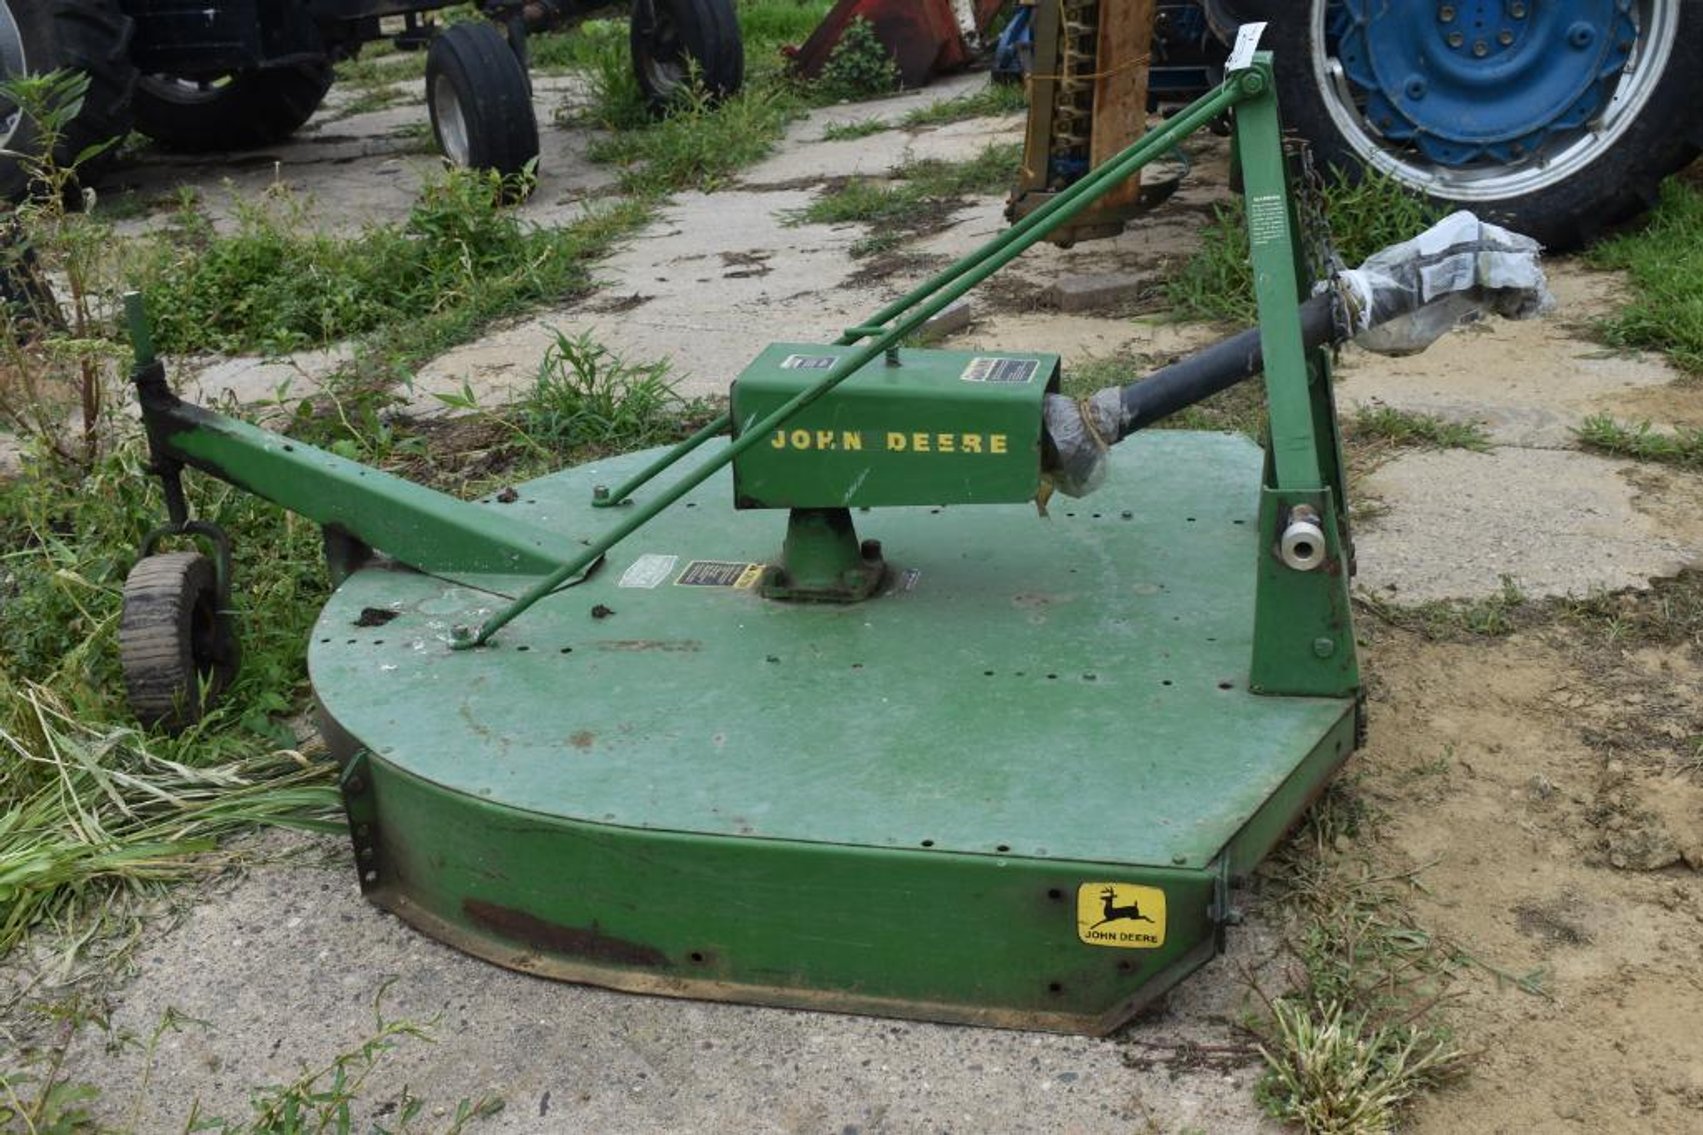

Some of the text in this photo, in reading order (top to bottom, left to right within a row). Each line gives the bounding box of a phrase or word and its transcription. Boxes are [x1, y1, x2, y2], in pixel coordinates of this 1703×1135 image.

[771, 430, 1008, 453] JOHN DEERE
[1085, 930, 1158, 943] JOHN DEERE
